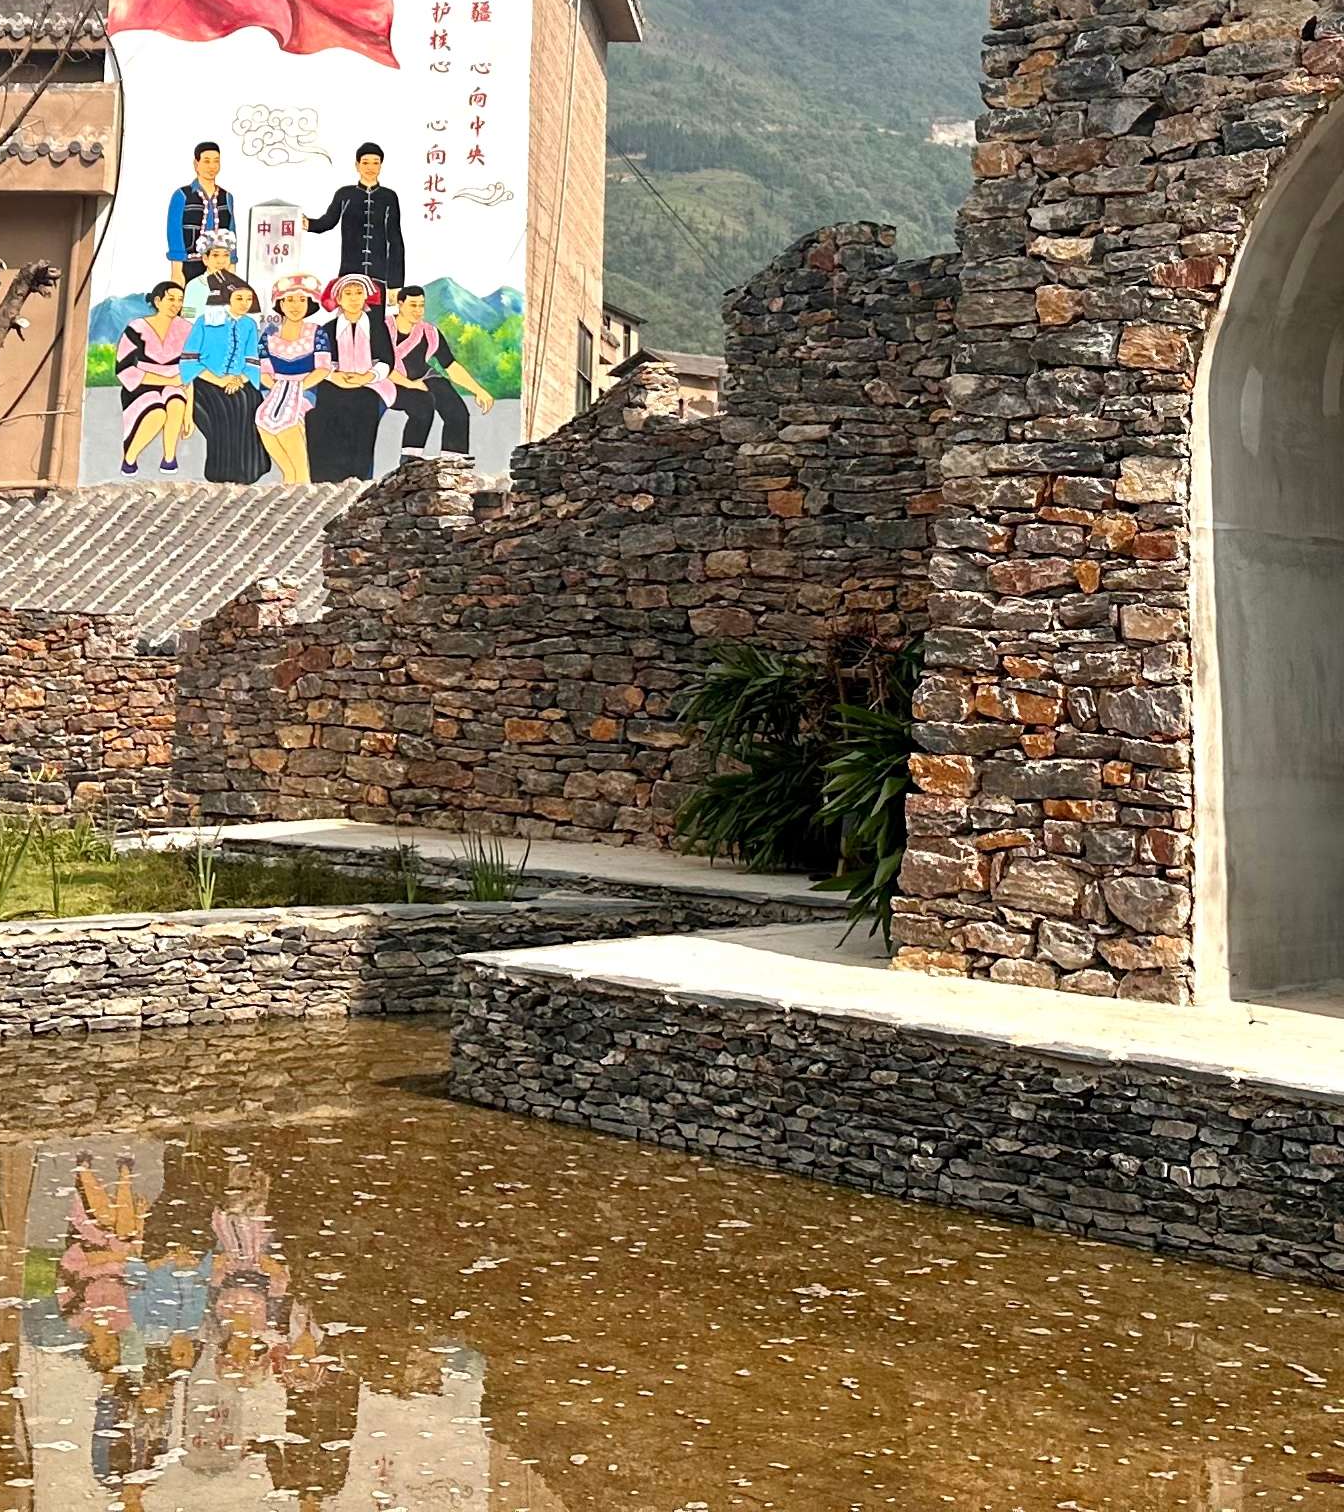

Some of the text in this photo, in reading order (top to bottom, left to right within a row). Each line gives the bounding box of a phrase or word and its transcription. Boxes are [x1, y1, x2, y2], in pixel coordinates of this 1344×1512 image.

[467, 62, 492, 166] 心向中央
[423, 119, 448, 221] 心向北京
[257, 219, 295, 237] 中国
[266, 243, 290, 256] 168
